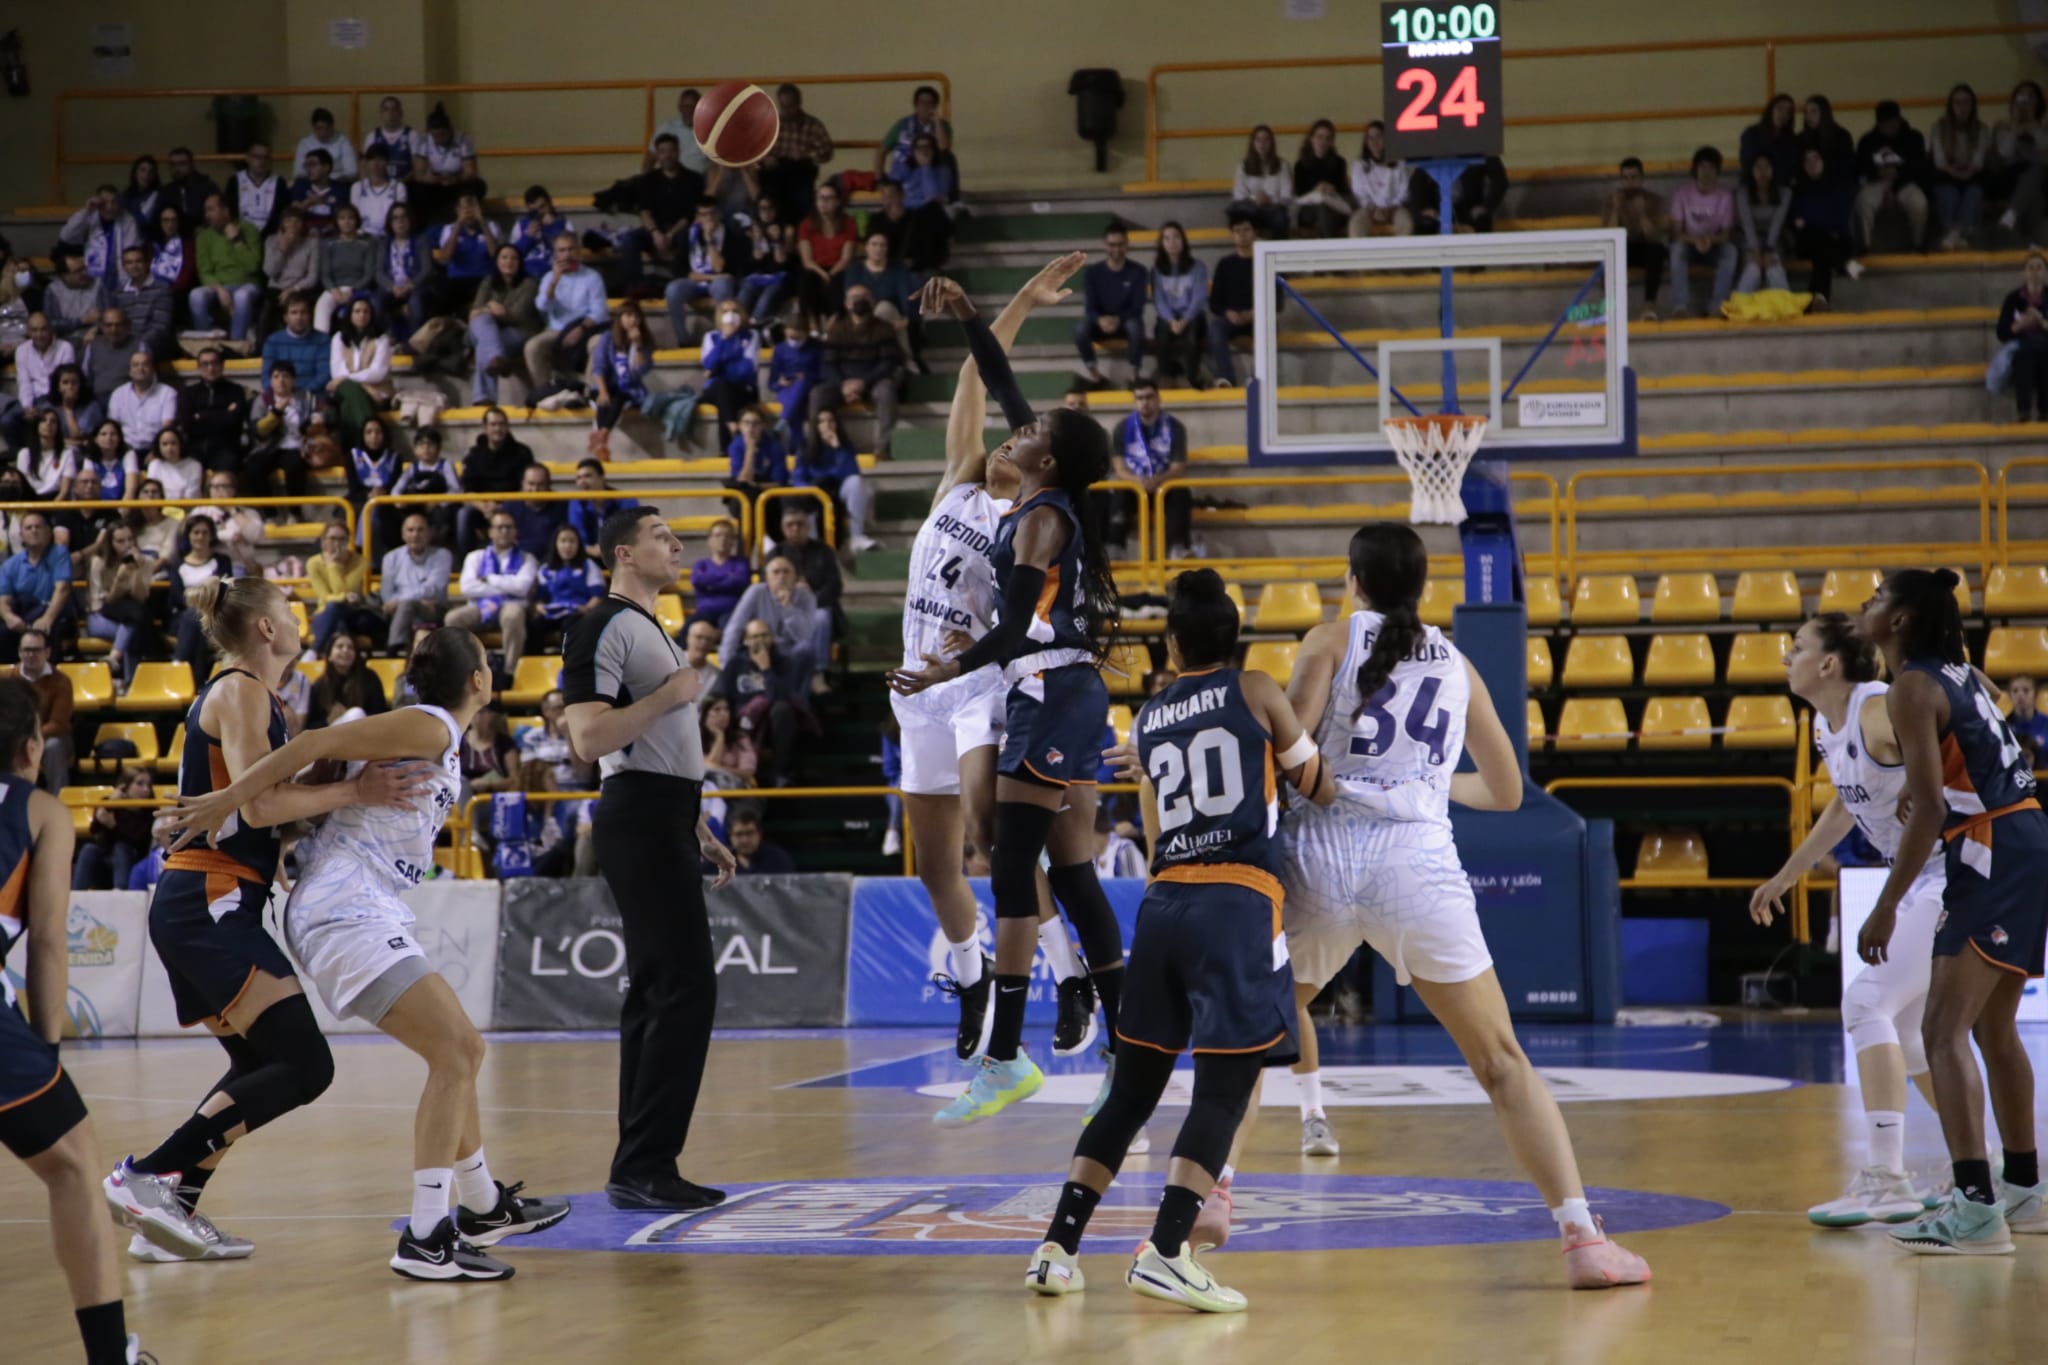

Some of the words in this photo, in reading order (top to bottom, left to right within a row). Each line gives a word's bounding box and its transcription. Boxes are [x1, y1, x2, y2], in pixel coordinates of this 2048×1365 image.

[1390, 4, 1495, 43] 10:00
[1396, 66, 1485, 131] 24
[926, 548, 962, 590] 24
[1143, 686, 1229, 734] JANUARY
[1351, 676, 1451, 766] 34
[1149, 726, 1245, 832] 20
[1527, 991, 1578, 1003] MONDO
